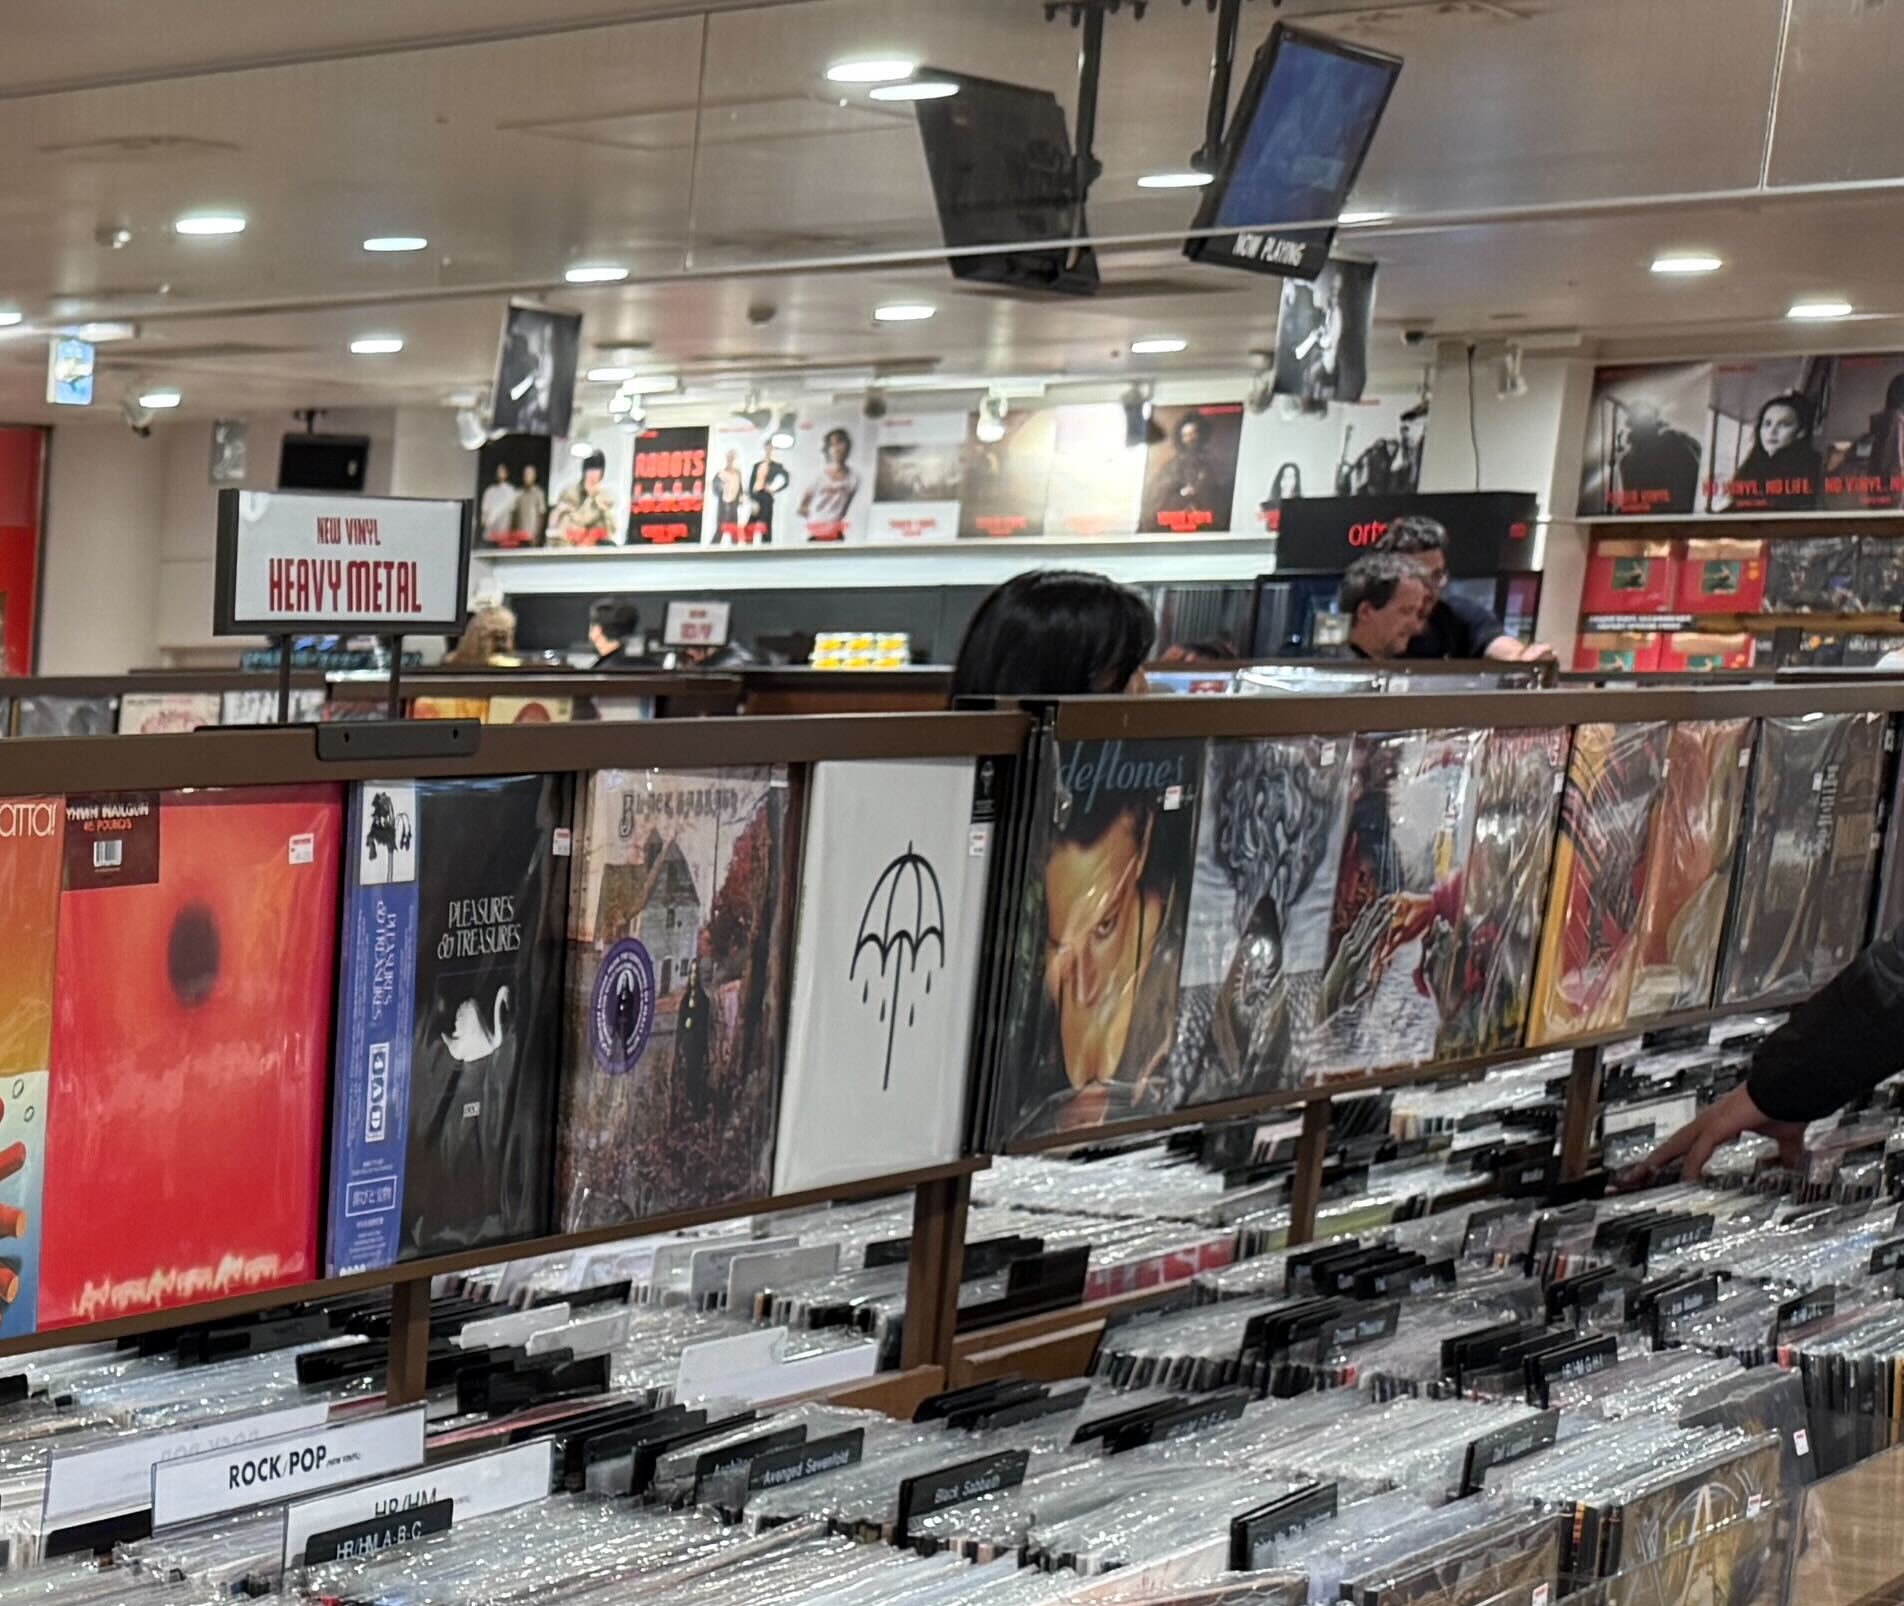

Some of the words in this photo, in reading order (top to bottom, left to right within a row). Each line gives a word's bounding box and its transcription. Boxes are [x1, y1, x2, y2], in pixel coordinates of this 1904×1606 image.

[1233, 232, 1262, 258] NOW
[1261, 237, 1306, 267] PLAYING
[317, 517, 341, 544] NEW
[345, 517, 380, 545] VINYL
[270, 558, 343, 612] HEAVY
[346, 560, 423, 613] METAL
[1059, 742, 1183, 812] deftones
[448, 896, 514, 928] PLEASURES
[456, 924, 521, 957] TREASURES
[228, 1445, 327, 1490] ROCK/POP
